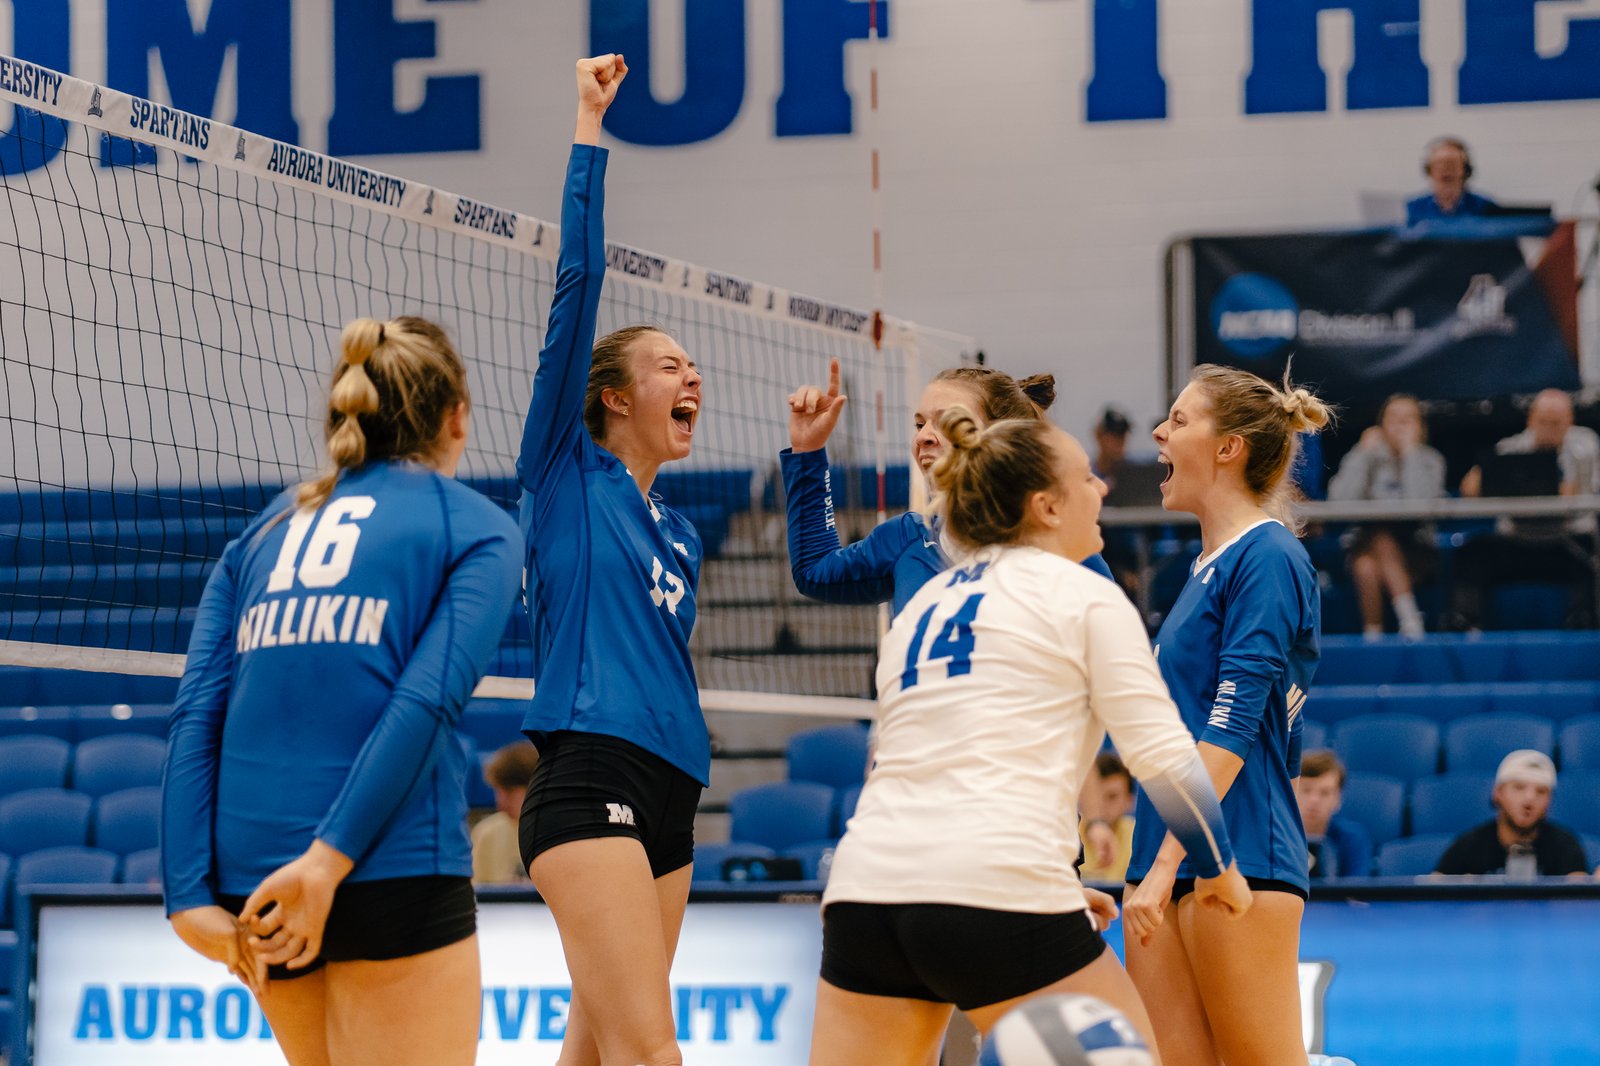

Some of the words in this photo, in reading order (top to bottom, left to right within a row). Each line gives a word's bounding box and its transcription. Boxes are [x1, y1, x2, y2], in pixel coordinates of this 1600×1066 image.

[130, 97, 210, 150] SPARTANS
[267, 142, 323, 185] AURORA
[327, 159, 407, 208] UNIVERSITY
[454, 198, 517, 239] SPARTANS
[266, 496, 377, 593] 16
[900, 593, 986, 692] 14
[606, 803, 636, 826] M
[75, 986, 274, 1041] AURO
